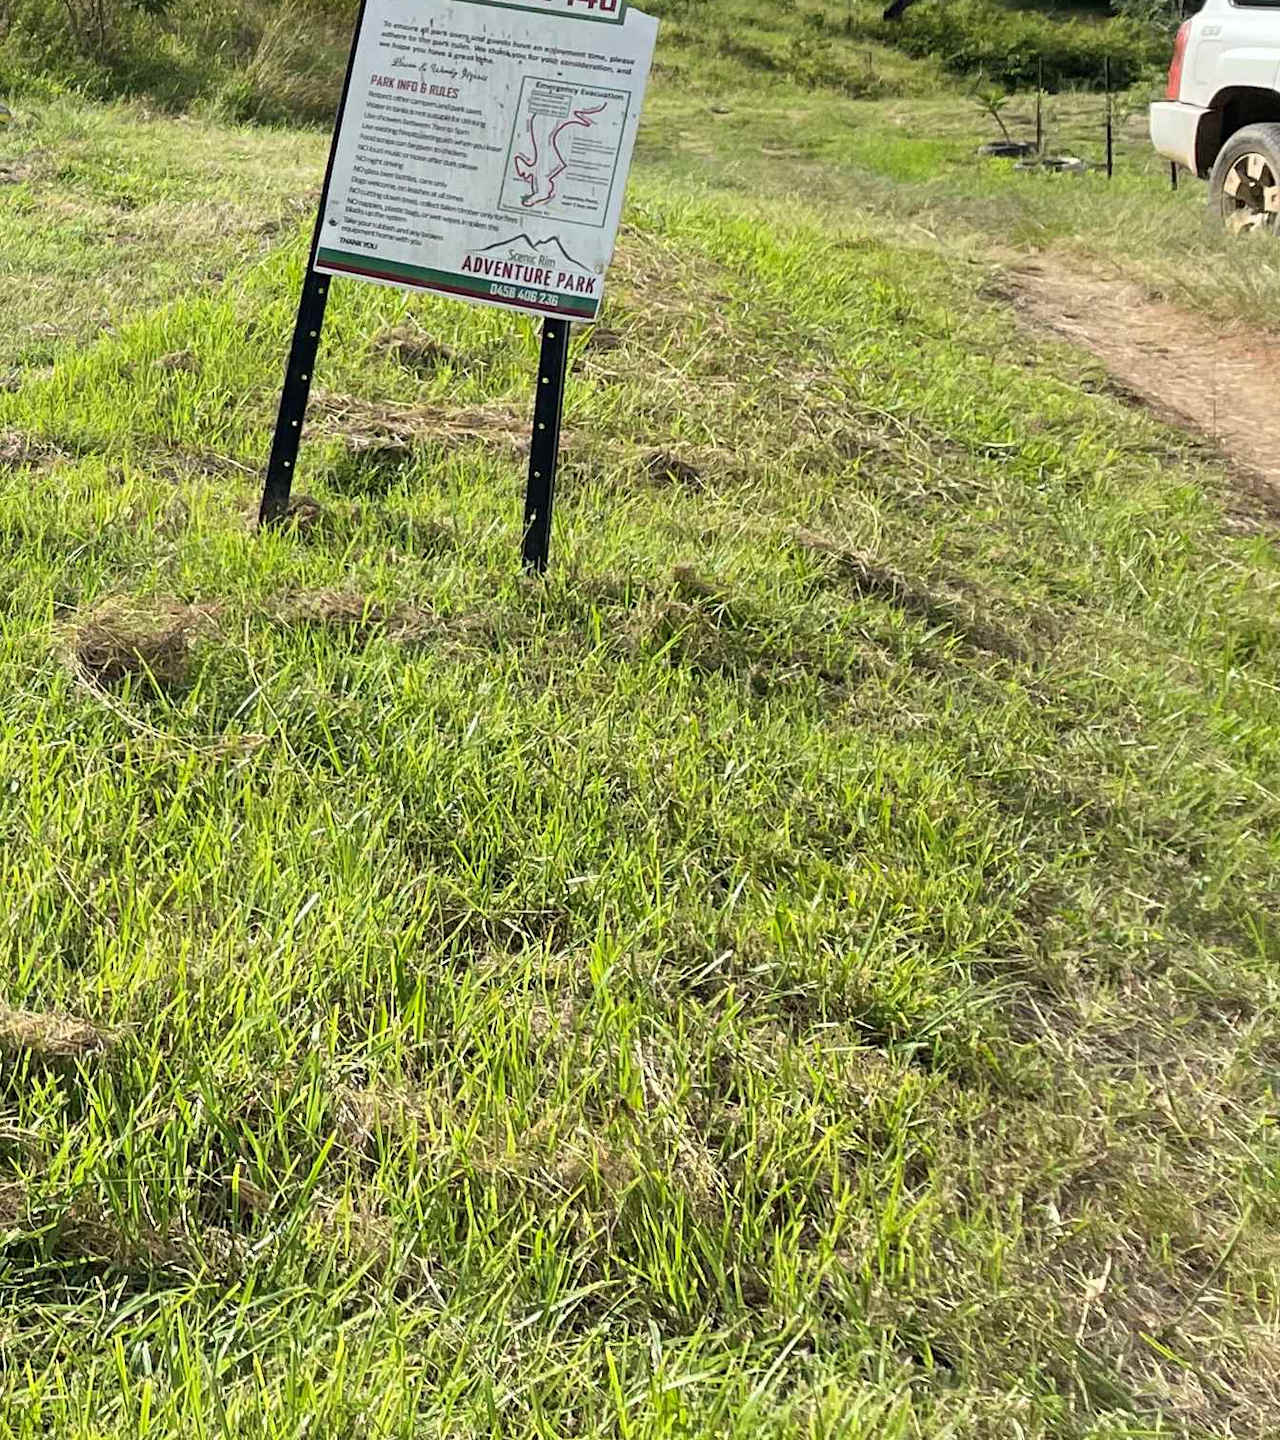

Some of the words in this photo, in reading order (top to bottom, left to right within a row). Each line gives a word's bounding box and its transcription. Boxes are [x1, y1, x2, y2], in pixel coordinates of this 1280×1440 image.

[370, 74, 395, 88] PARK
[396, 79, 418, 92] INFO
[419, 82, 427, 93] &
[428, 84, 459, 99] RULES
[535, 80, 578, 94] Emergency
[579, 87, 624, 101] Evacuation
[508, 248, 536, 264] Scenic
[537, 253, 556, 268] Rim
[462, 255, 552, 286] ADVENTURE
[556, 272, 596, 293] PARK
